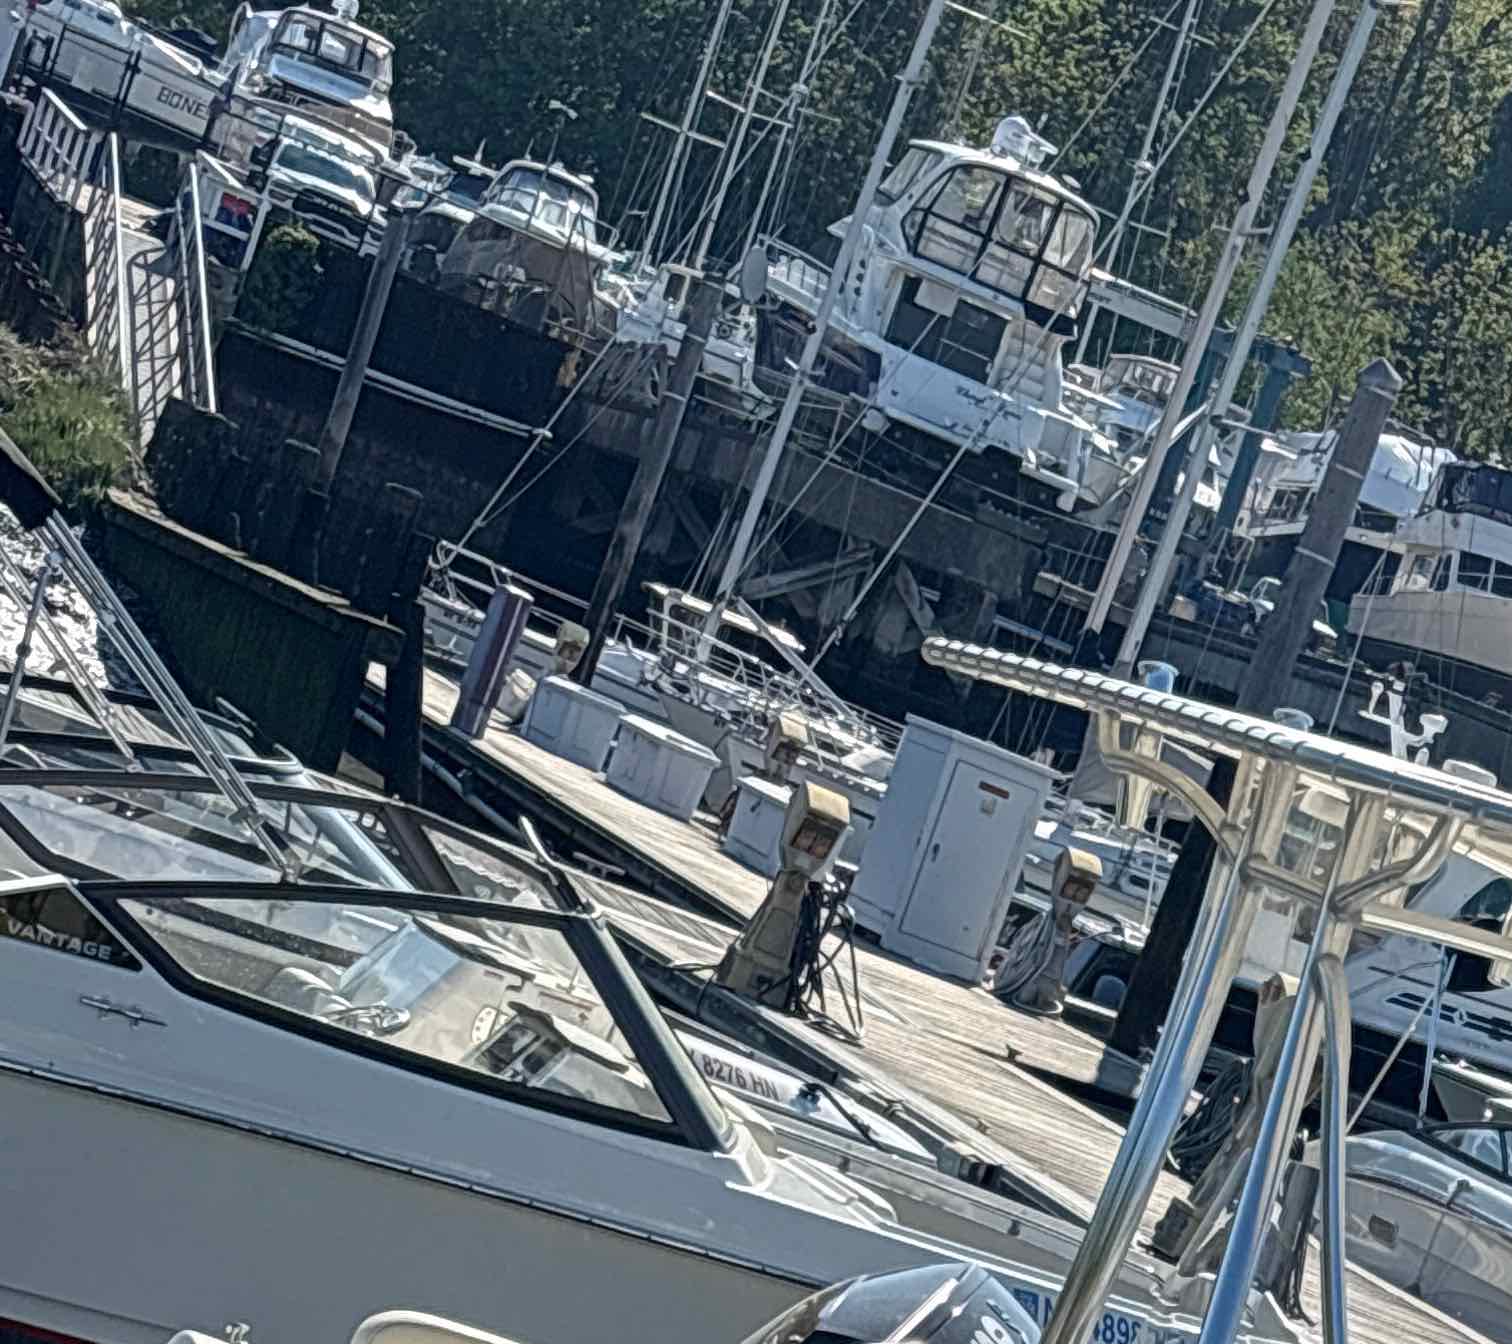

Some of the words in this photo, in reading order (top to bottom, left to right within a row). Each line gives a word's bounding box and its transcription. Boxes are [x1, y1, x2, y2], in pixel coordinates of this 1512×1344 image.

[7, 919, 112, 960] VANTAGE
[702, 1053, 747, 1090] 8276
[748, 1072, 780, 1101] HN
